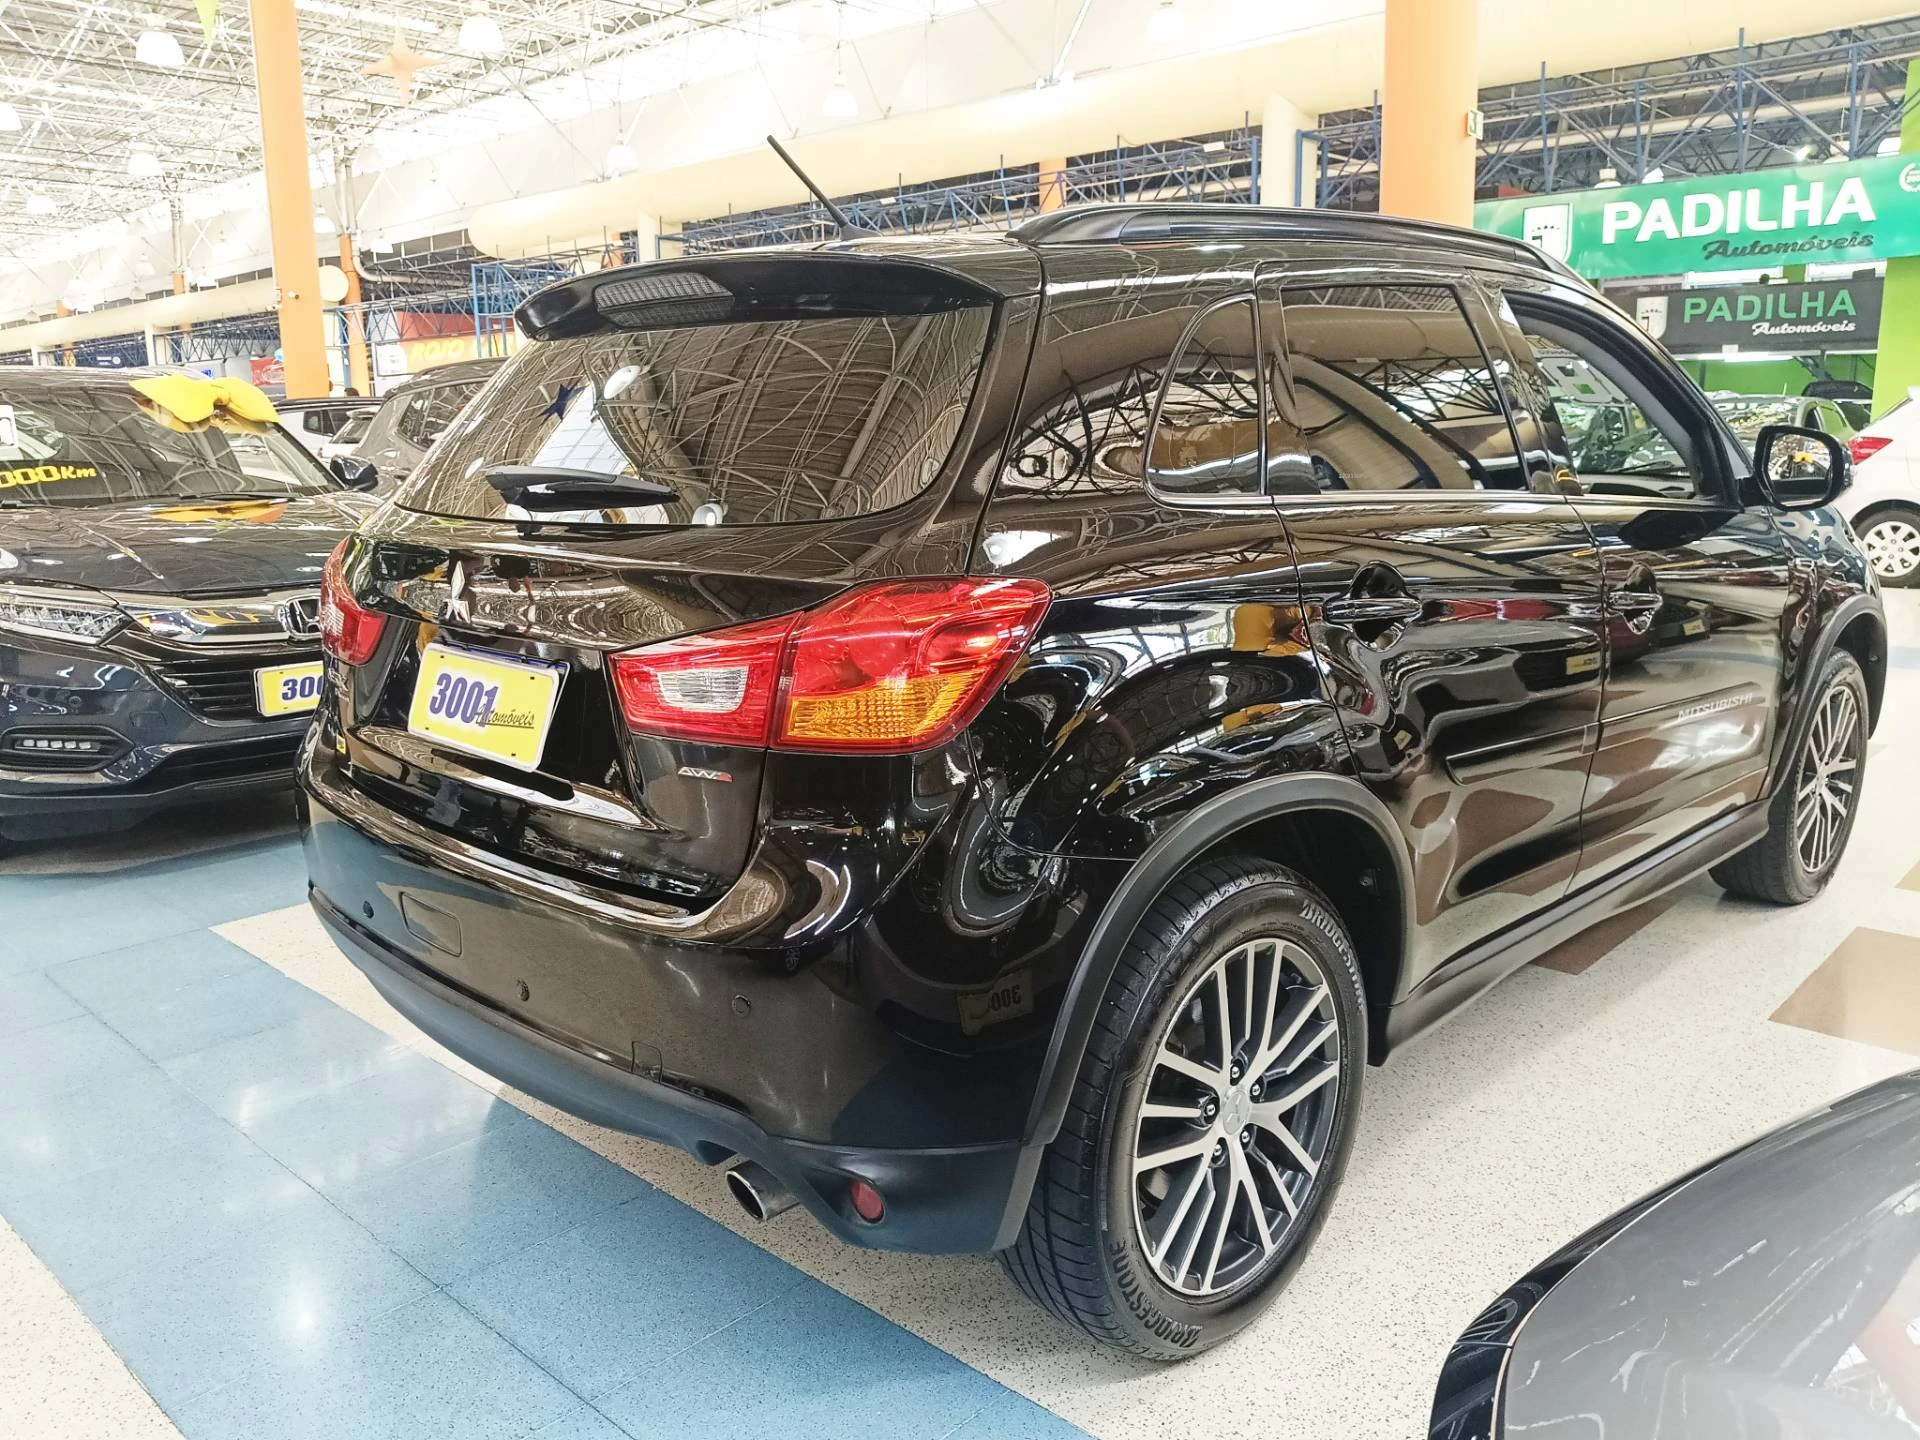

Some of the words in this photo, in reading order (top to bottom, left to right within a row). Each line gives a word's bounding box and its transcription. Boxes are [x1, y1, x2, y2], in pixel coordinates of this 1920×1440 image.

[1601, 177, 1877, 245] PADILHA
[1702, 231, 1874, 260] Automóveis
[1683, 289, 1856, 323] PADILHA
[1752, 320, 1856, 336] Automóveis
[429, 673, 499, 727] 3001
[1678, 693, 1753, 720] MITSUBISHI
[1110, 1238, 1202, 1348] BRIDGESTONE
